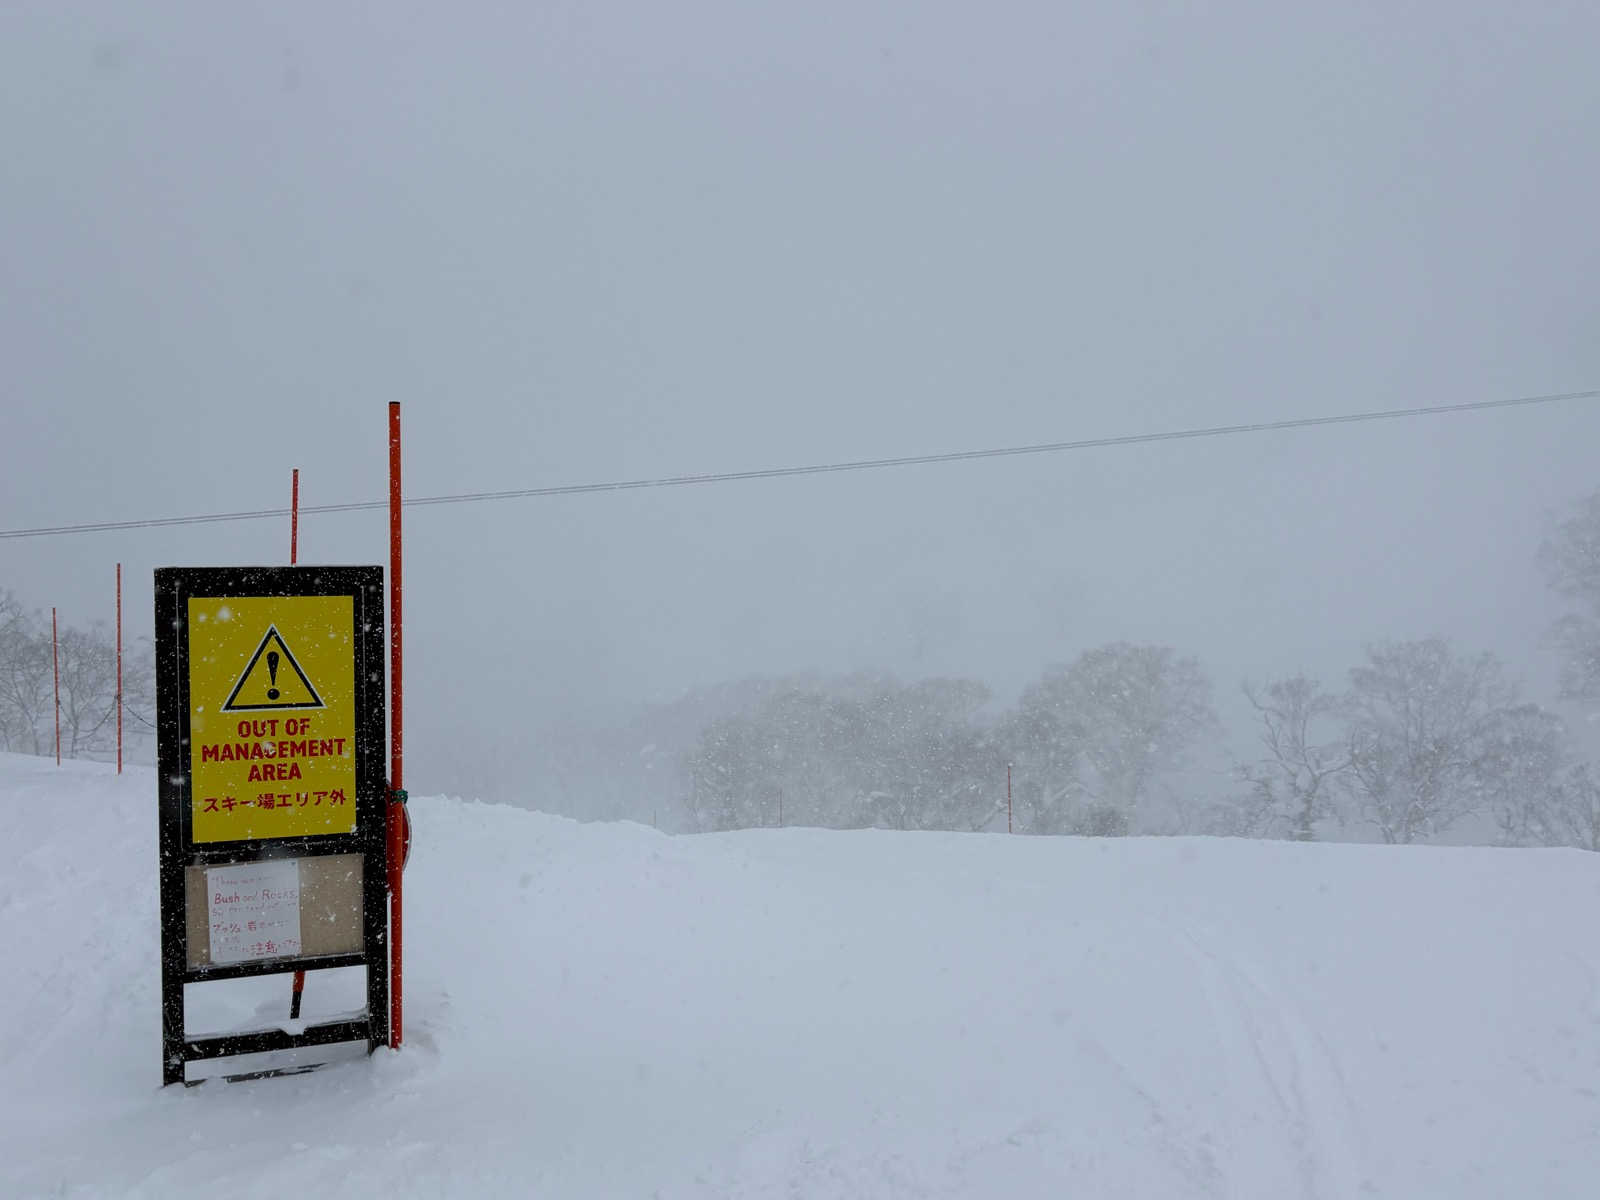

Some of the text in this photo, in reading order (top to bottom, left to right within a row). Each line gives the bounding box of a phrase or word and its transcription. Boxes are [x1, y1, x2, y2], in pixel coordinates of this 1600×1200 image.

[237, 718, 310, 738] OUT OF
[201, 738, 346, 762] MANAGEMENT
[248, 762, 302, 782] AREA
[203, 788, 347, 813] スキー場エリア外
[214, 891, 240, 905] Bush
